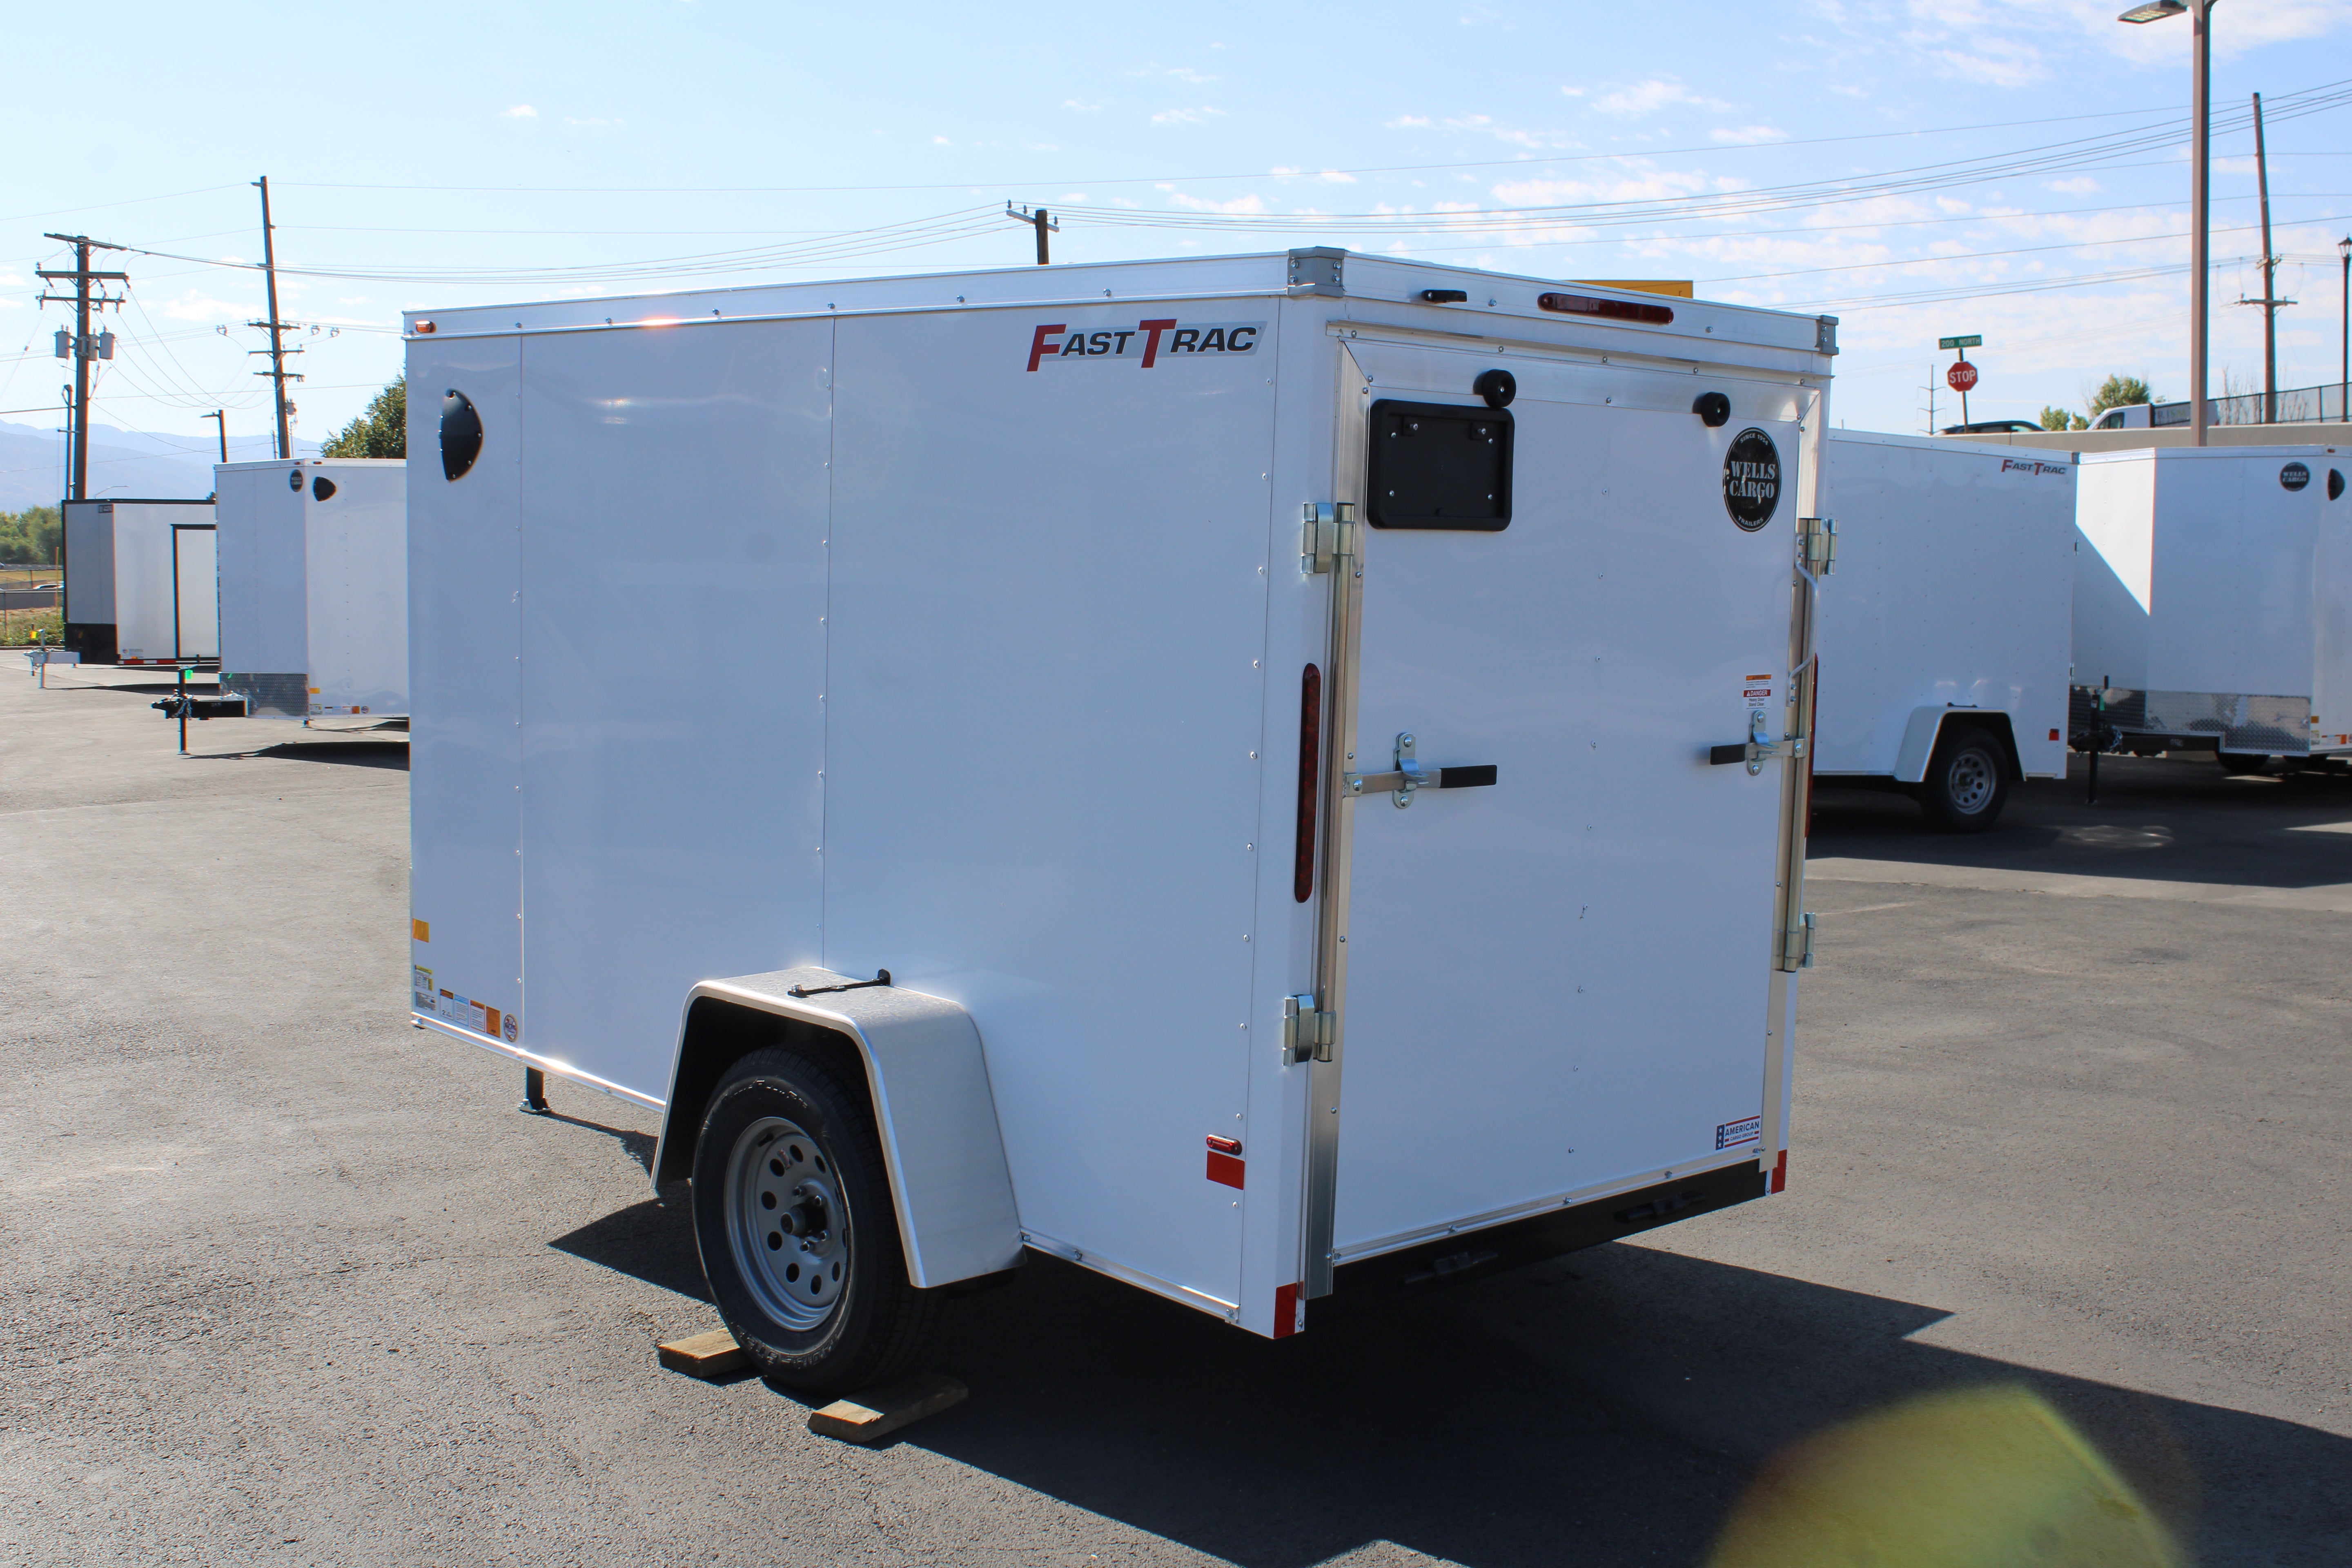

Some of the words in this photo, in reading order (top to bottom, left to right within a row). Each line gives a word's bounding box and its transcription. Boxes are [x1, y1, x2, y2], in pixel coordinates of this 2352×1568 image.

[1959, 336, 1980, 345] NORTH
[1949, 370, 1976, 383] STOP
[1740, 433, 1755, 443] SINCE
[1757, 434, 1768, 445] 1954
[1731, 461, 1775, 479] WELLS
[1729, 480, 1775, 498] CARGO
[1738, 515, 1764, 526] TRAILERS
[1725, 1121, 1760, 1136] AMERICAN
